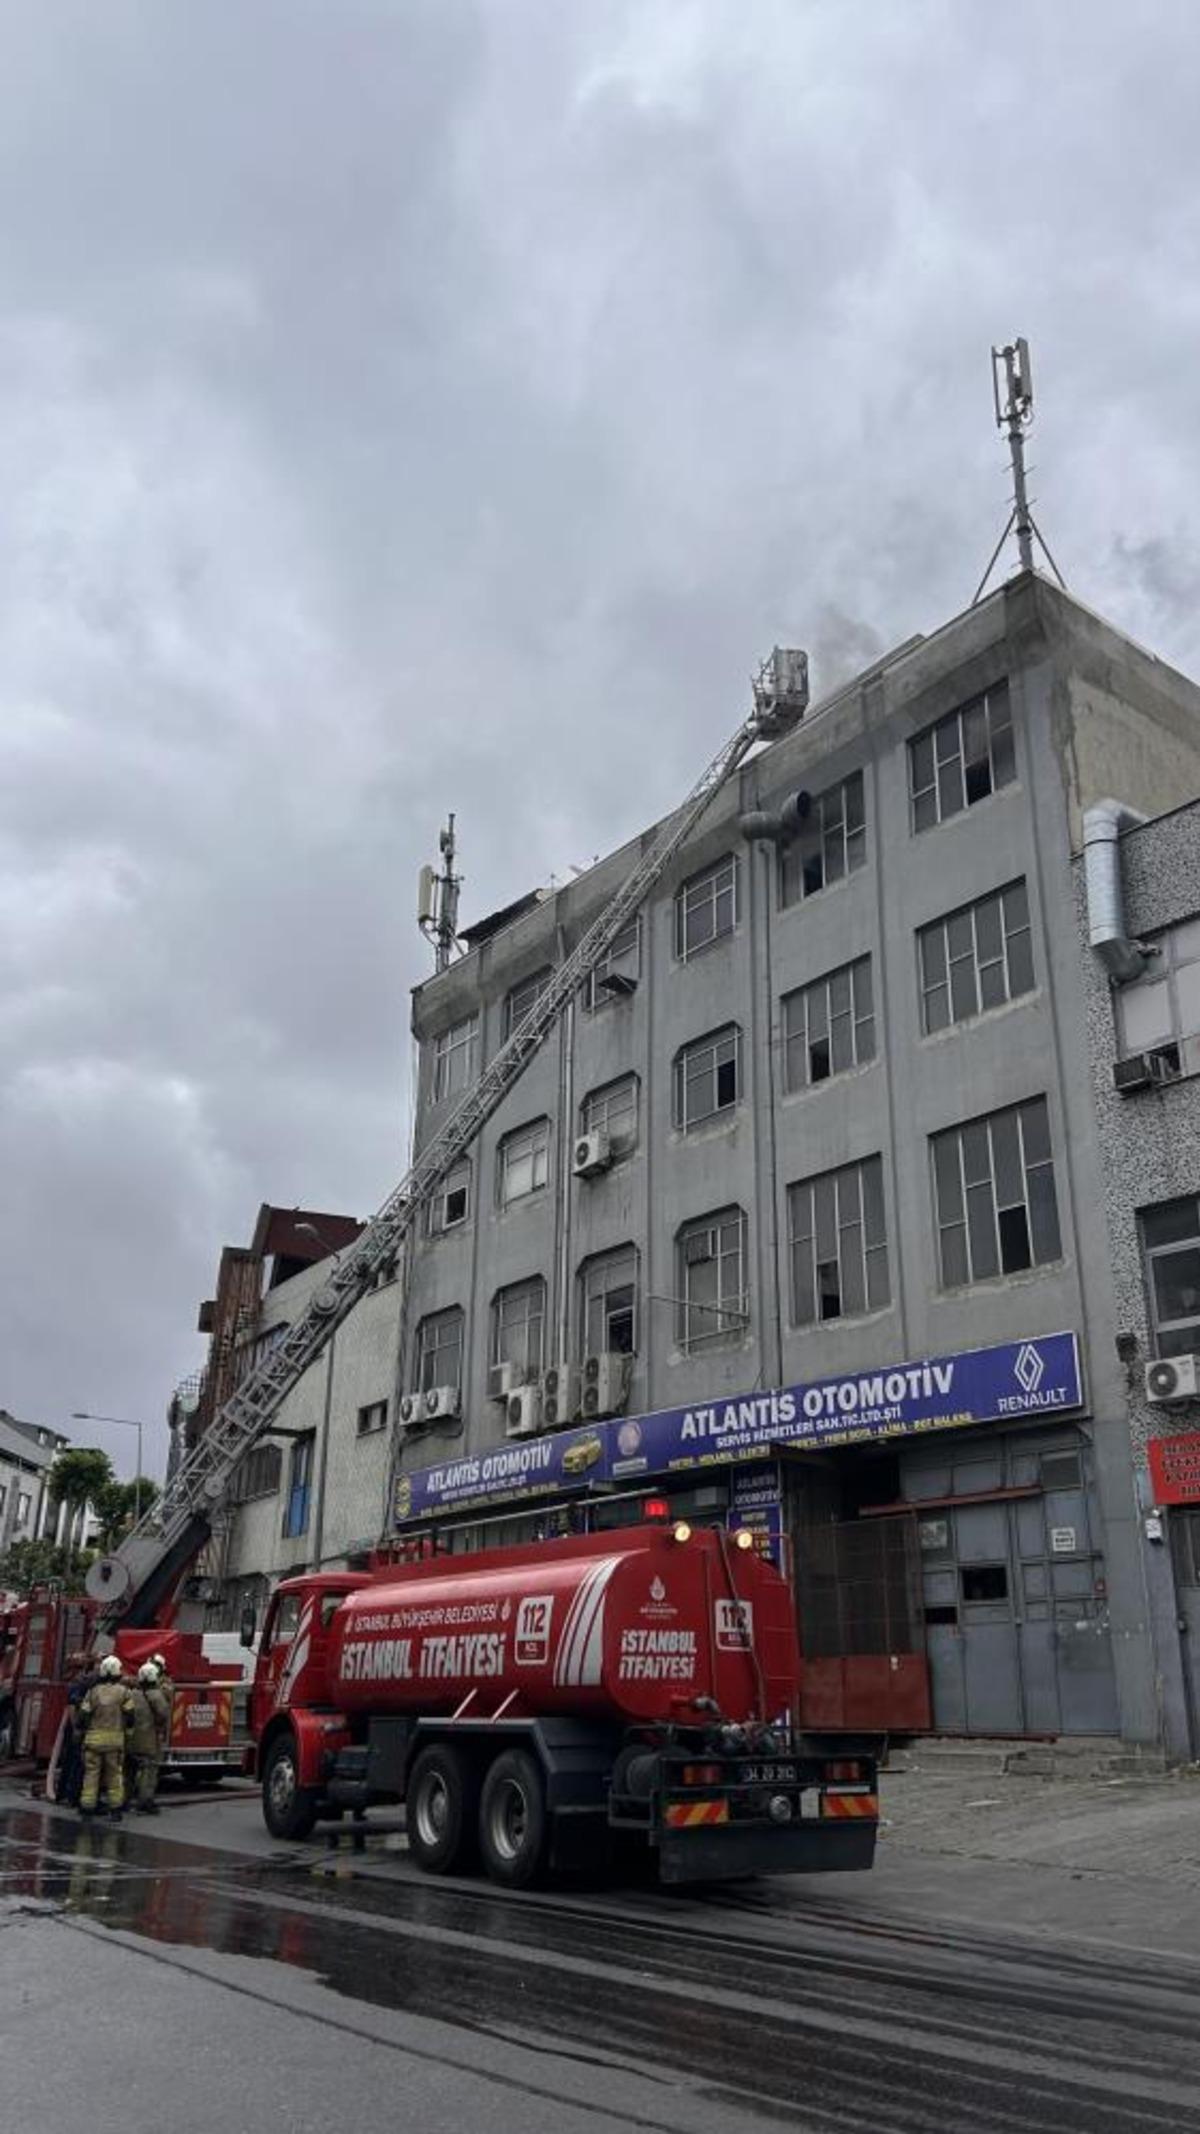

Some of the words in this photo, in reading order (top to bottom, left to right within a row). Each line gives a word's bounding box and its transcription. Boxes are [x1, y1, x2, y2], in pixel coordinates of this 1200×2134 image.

[681, 1390, 796, 1440] ATLANTİS
[803, 1361, 954, 1417] OTOMOTİV
[998, 1387, 1067, 1413] RENAULT
[427, 1459, 480, 1493] ATLANTİS
[482, 1441, 552, 1480] OTOMOTİV
[523, 1603, 547, 1634] 112
[621, 1630, 698, 1654] İSTANBUL
[619, 1655, 696, 1680] İTFAİYESİ
